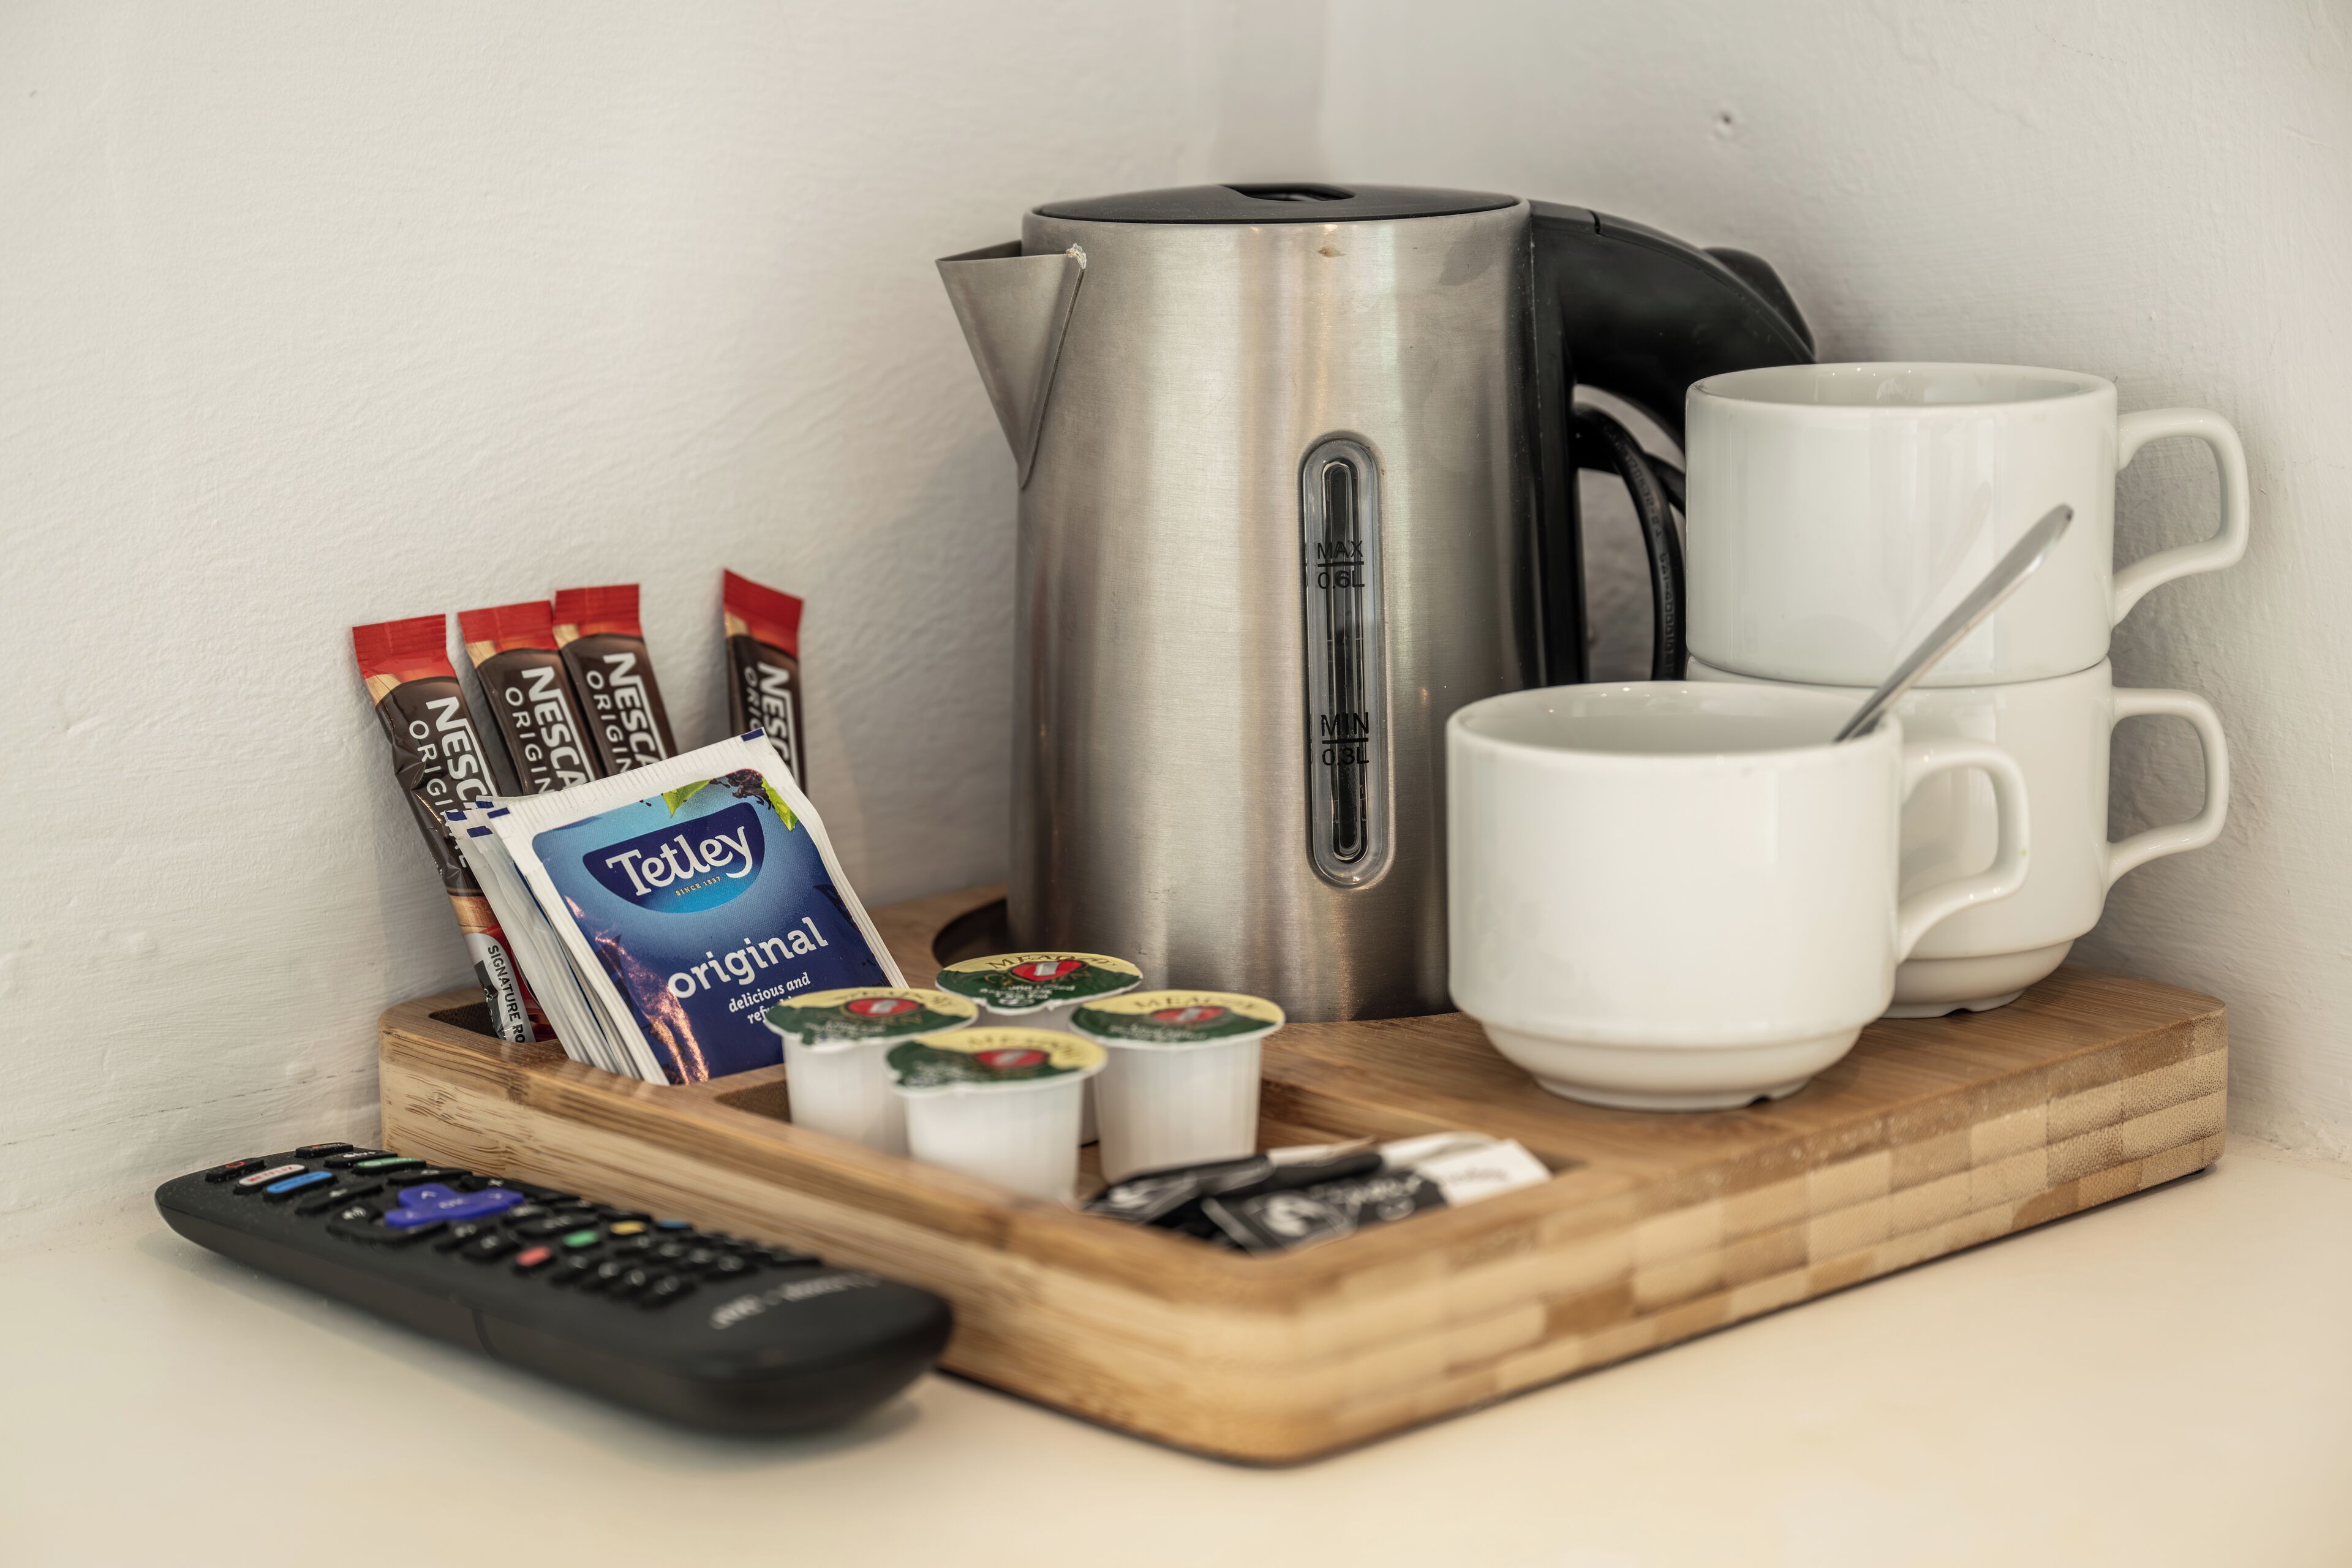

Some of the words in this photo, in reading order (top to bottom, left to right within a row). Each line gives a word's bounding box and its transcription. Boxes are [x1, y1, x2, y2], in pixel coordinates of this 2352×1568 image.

[1317, 540, 1363, 559] MAX
[1317, 570, 1365, 589] 0.6L
[1321, 712, 1370, 737] MIN
[1322, 747, 1370, 766] 0.3L
[605, 826, 753, 897] Tetley
[676, 883, 702, 897] SINCE
[703, 876, 721, 886] 1837
[668, 916, 829, 998] original
[488, 944, 521, 1022] SIGNATURE
[729, 984, 785, 1012] delicious
[786, 972, 811, 991] and
